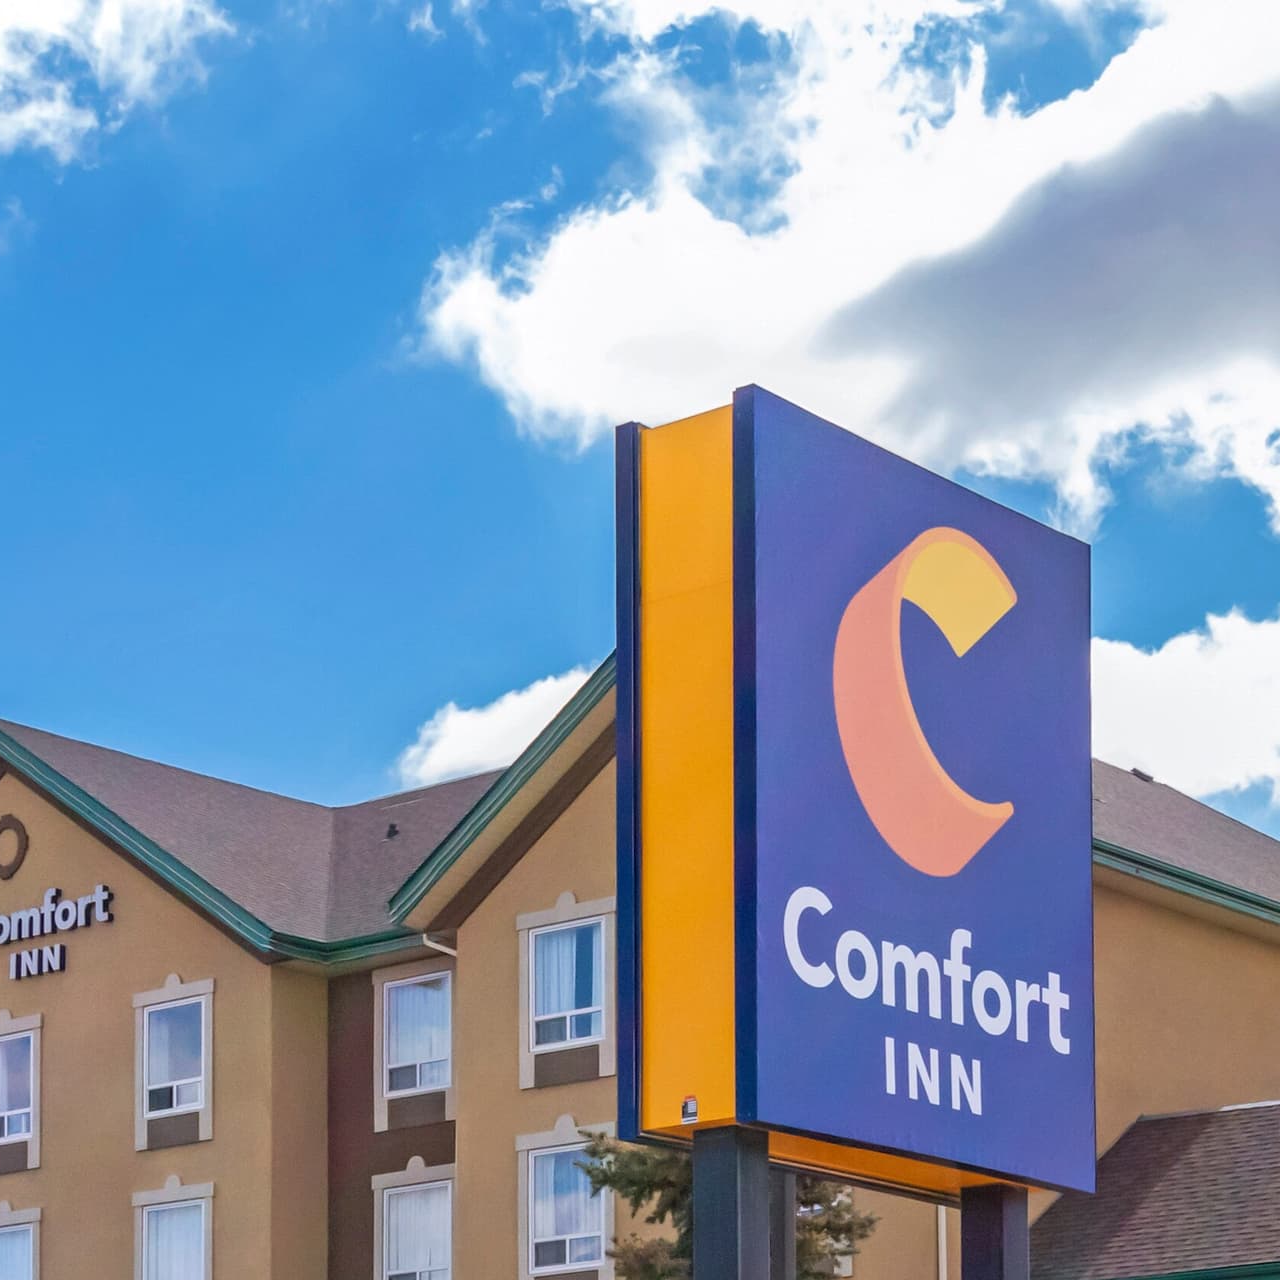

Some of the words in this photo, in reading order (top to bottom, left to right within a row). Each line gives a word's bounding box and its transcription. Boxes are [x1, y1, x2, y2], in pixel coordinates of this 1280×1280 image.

[9, 943, 65, 980] INN
[783, 886, 1070, 1055] Comfort
[885, 1036, 982, 1116] INN
